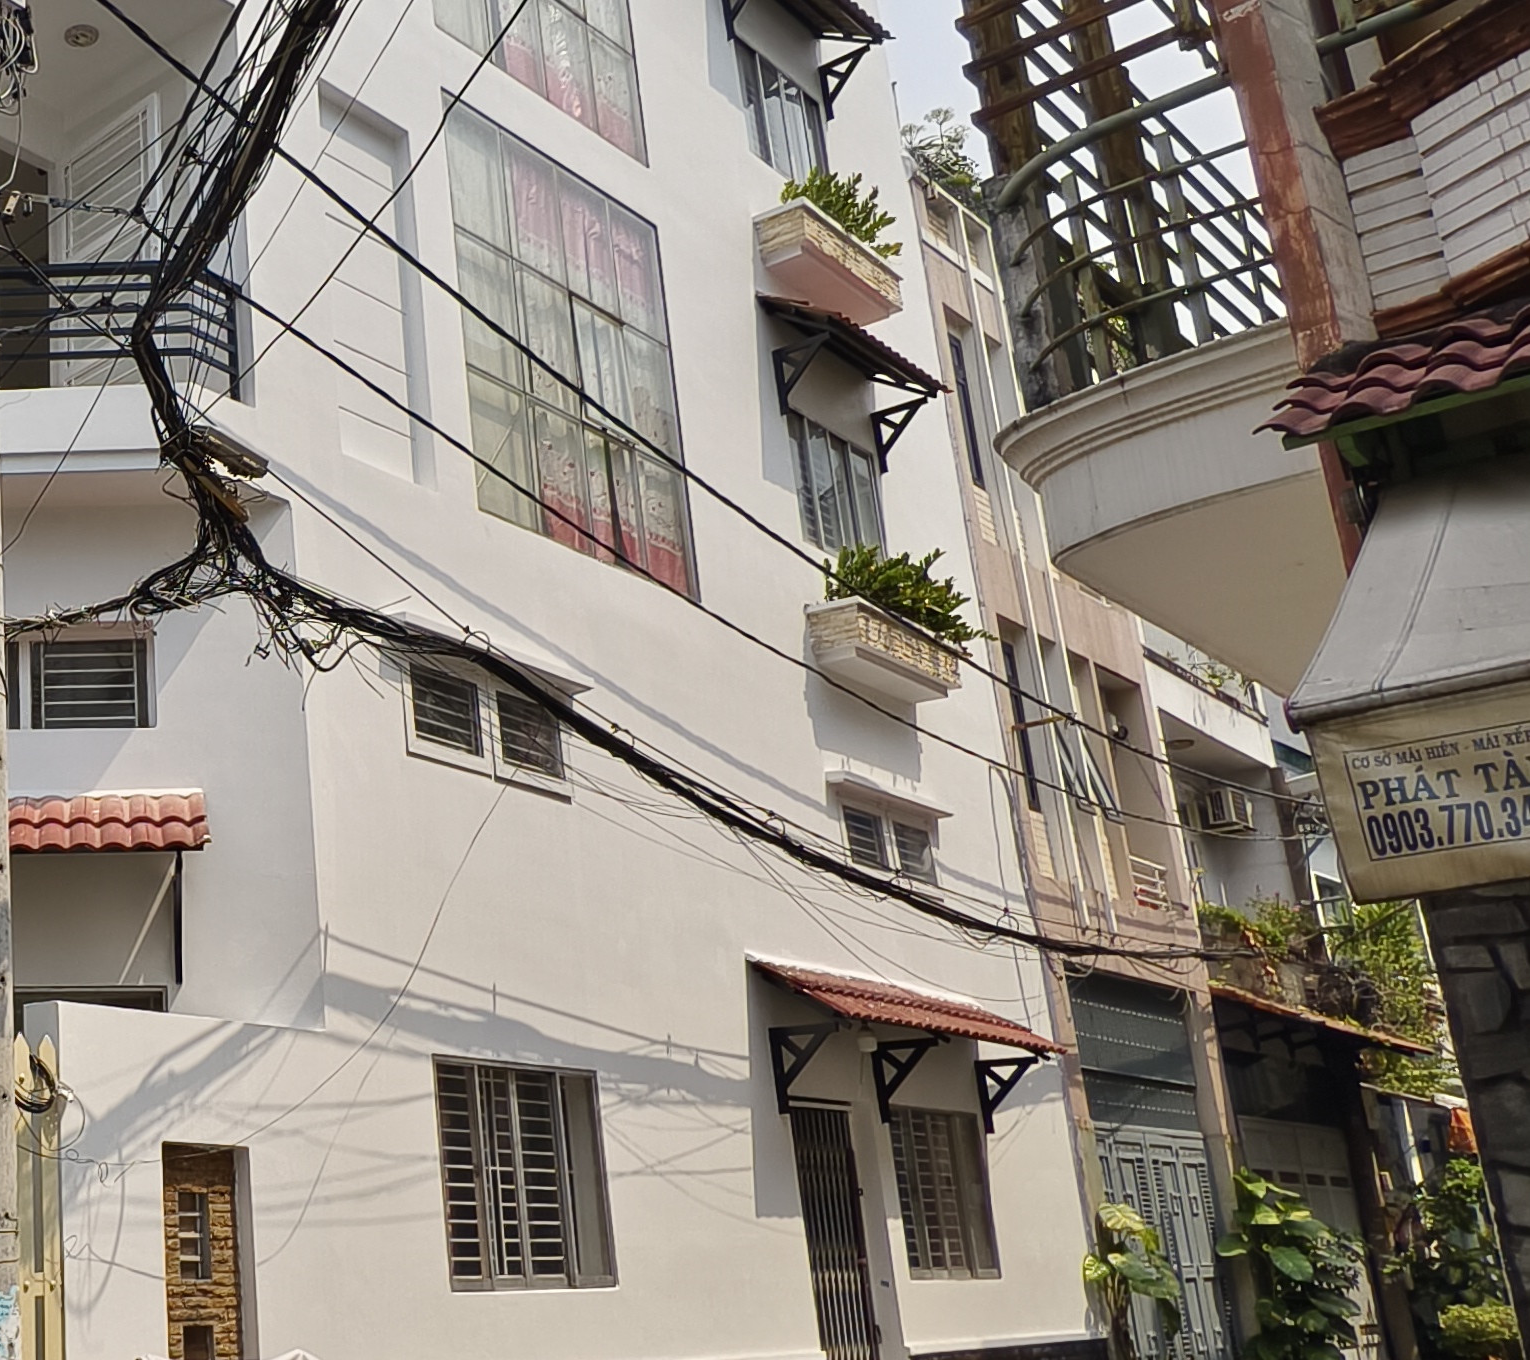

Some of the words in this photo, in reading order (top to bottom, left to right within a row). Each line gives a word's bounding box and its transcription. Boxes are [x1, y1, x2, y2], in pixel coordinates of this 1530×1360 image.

[1351, 755, 1370, 770] CƠ
[1395, 746, 1423, 765] MÁI
[1472, 735, 1501, 752] MÁI
[1357, 765, 1462, 810] PHÁT
[1474, 750, 1530, 794] TÀ
